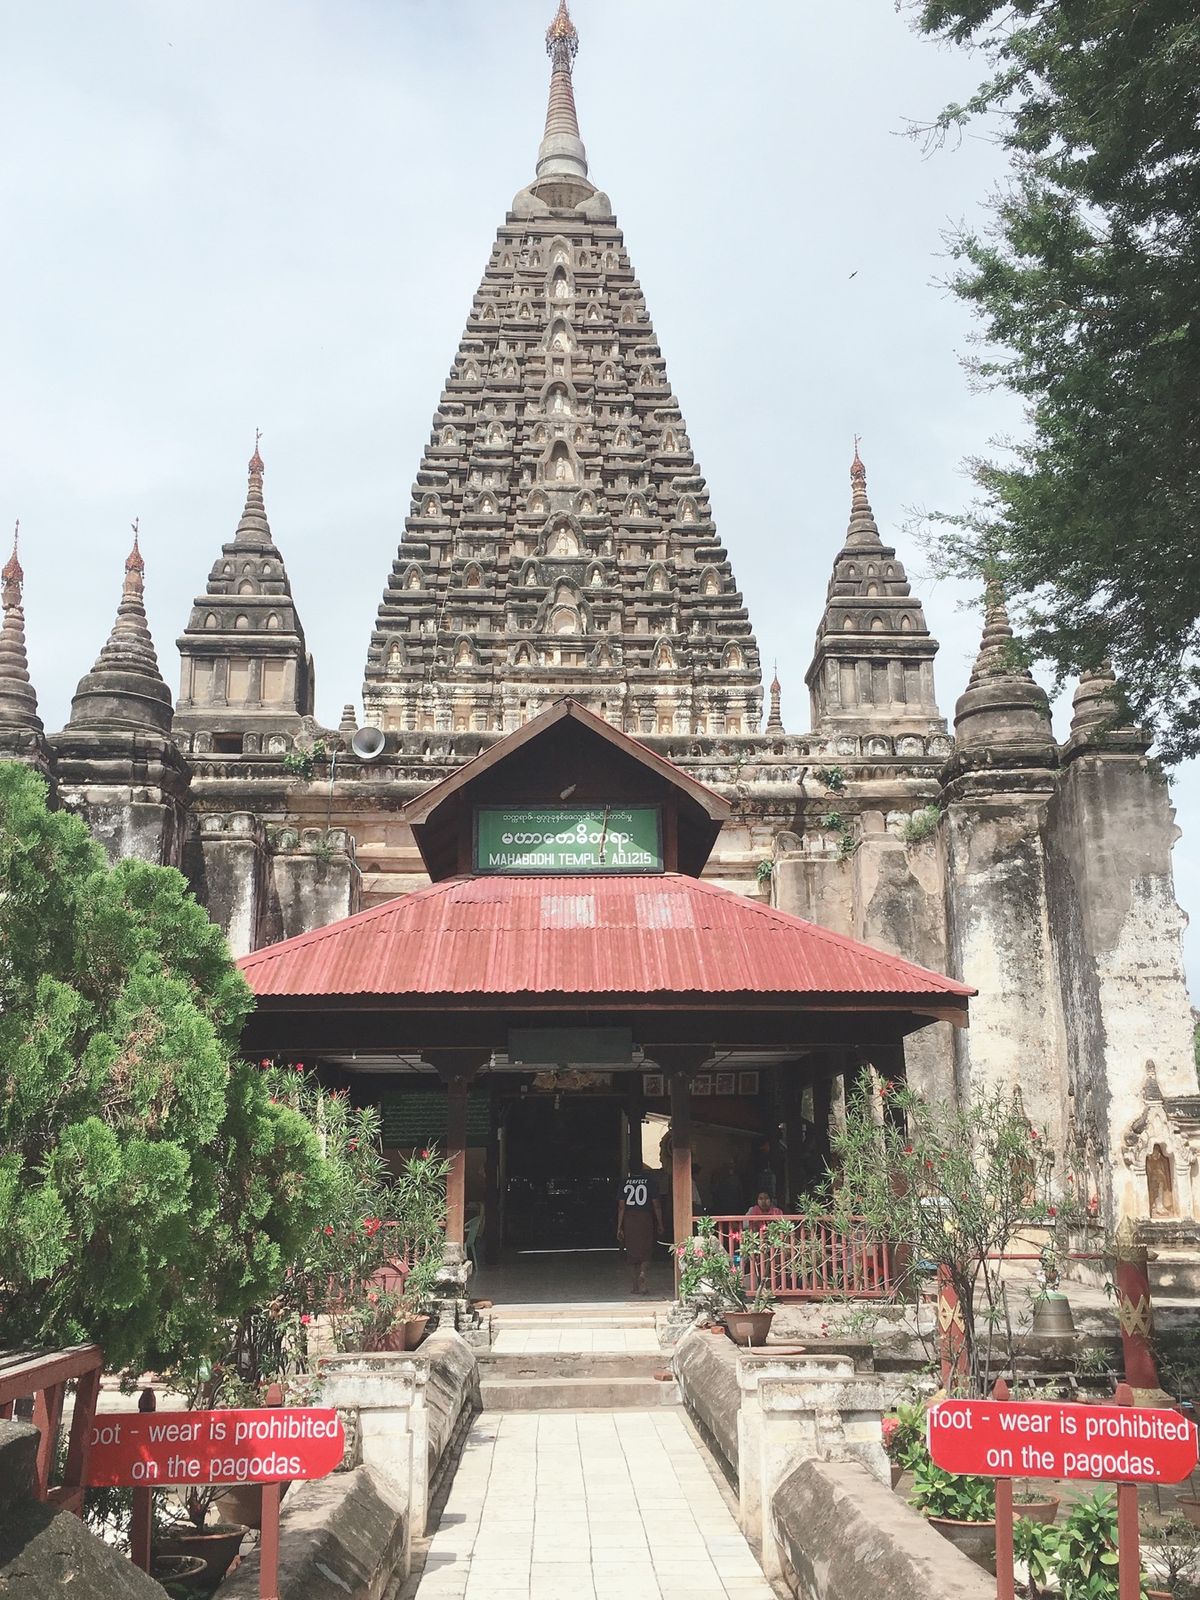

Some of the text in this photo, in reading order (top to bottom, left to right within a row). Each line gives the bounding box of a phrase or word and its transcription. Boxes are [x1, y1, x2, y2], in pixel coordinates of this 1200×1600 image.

[489, 853, 555, 865] MAHABODHI
[559, 852, 606, 865] TEMPLE
[623, 1184, 648, 1206] 20
[91, 1423, 121, 1446] oot
[149, 1422, 202, 1443] wear
[209, 1417, 226, 1441] is
[235, 1415, 339, 1446] prohibited
[931, 1404, 973, 1429] foot
[999, 1412, 1052, 1433] wear
[1060, 1411, 1077, 1435] is
[1086, 1413, 1190, 1441] prohibited
[131, 1451, 307, 1482] on the pagodas.
[987, 1445, 1161, 1478] on the pagodas.
